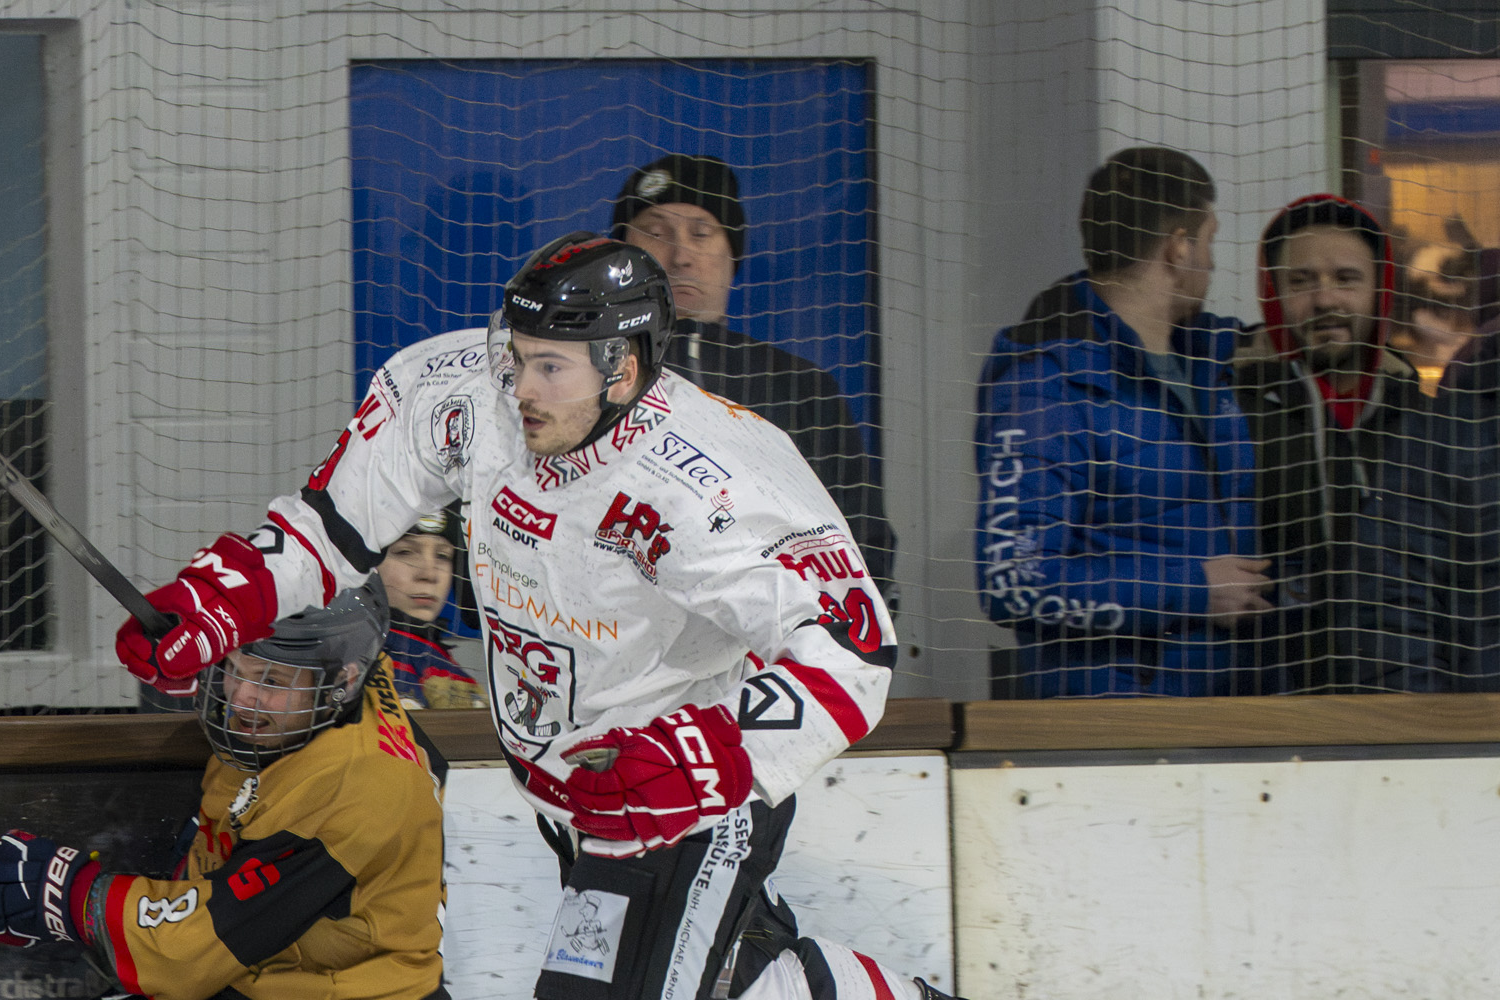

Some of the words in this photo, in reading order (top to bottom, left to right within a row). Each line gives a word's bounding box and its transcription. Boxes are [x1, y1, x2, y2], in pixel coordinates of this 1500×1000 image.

[512, 294, 543, 312] CCM
[618, 312, 652, 330] CCM
[496, 492, 552, 531] CCM
[492, 516, 511, 537] ALL
[511, 529, 539, 550] OUT.
[660, 707, 727, 809] CCM
[43, 846, 80, 942] BAUER
[672, 919, 694, 972] MICHAEL
